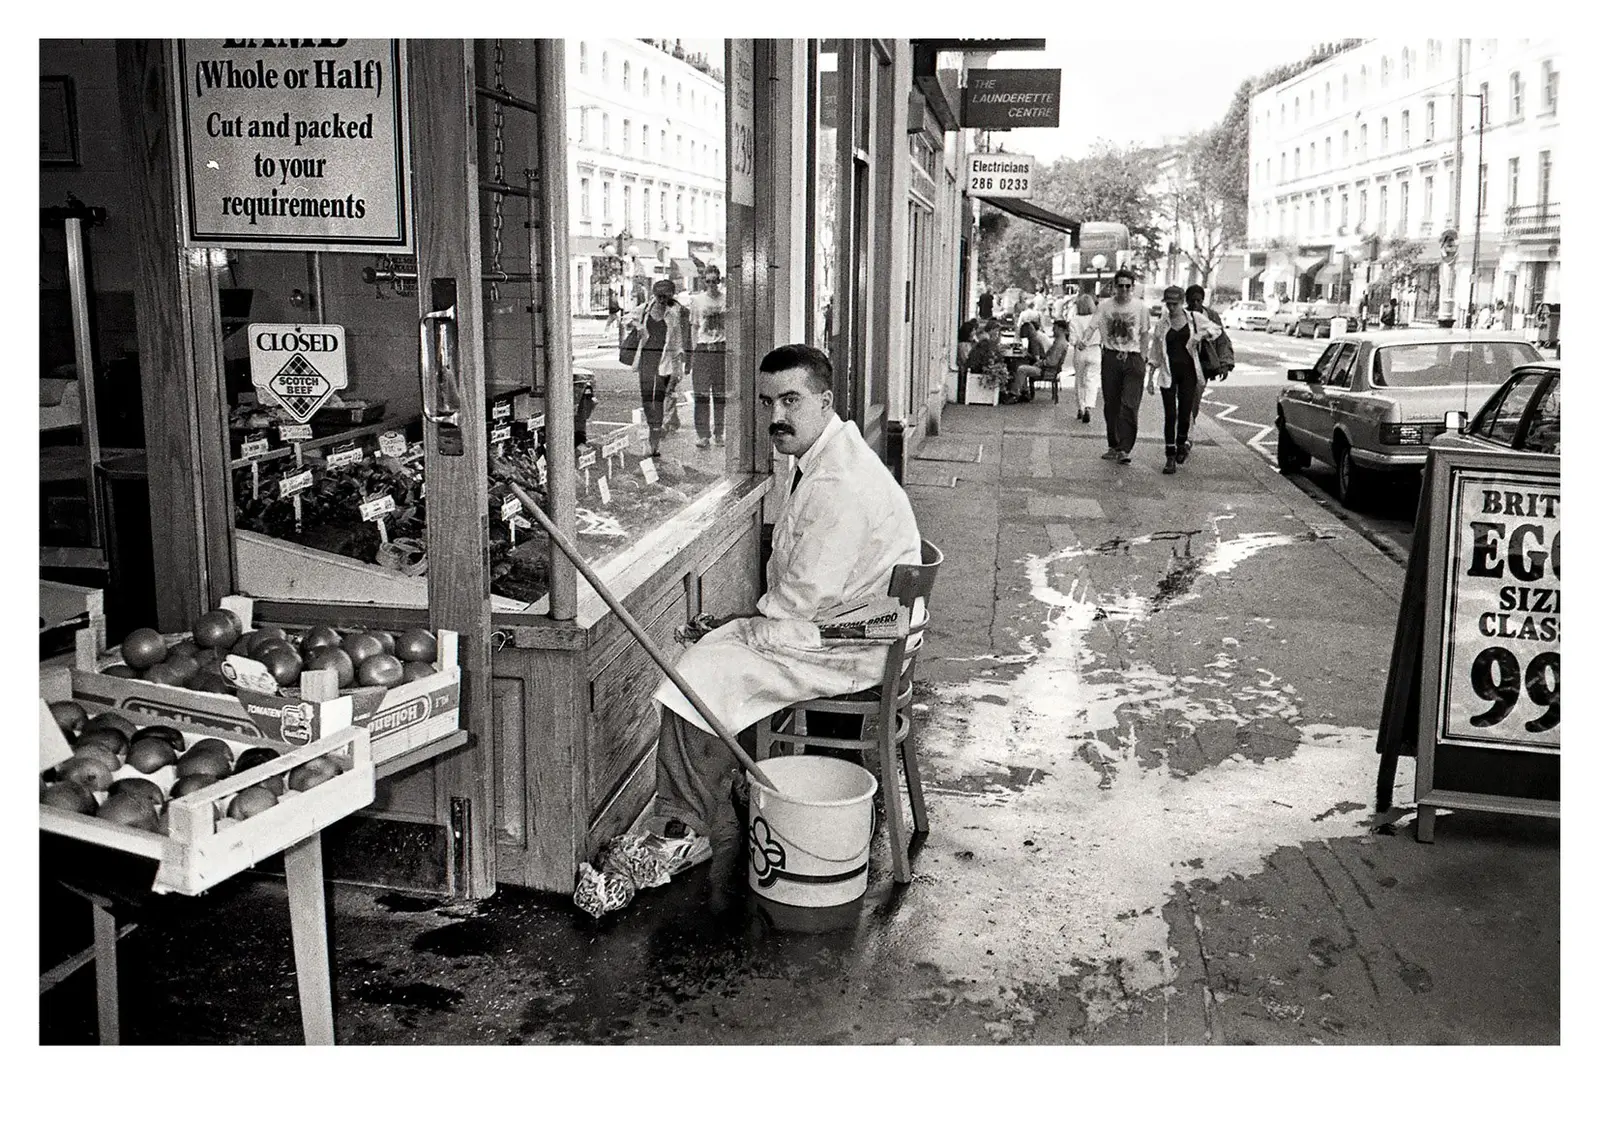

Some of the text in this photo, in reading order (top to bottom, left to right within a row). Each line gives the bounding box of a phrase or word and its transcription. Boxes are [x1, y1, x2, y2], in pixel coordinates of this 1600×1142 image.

[196, 59, 382, 98] (Whole or Half)
[974, 79, 996, 89] THE
[972, 93, 1054, 103] LAUNDERETTE
[1008, 108, 1053, 117] CENTRE
[206, 112, 373, 146] Cut and packed
[254, 152, 326, 185] to your
[972, 160, 1029, 173] Electricians
[972, 177, 1028, 191] 286 0233
[222, 188, 366, 225] requirements
[256, 332, 339, 353] CLOSED
[279, 376, 319, 386] SCOTCH
[286, 386, 313, 395] BEEF
[1467, 520, 1560, 582] EG
[1478, 612, 1560, 643] CLAS
[1469, 646, 1560, 733] 99
